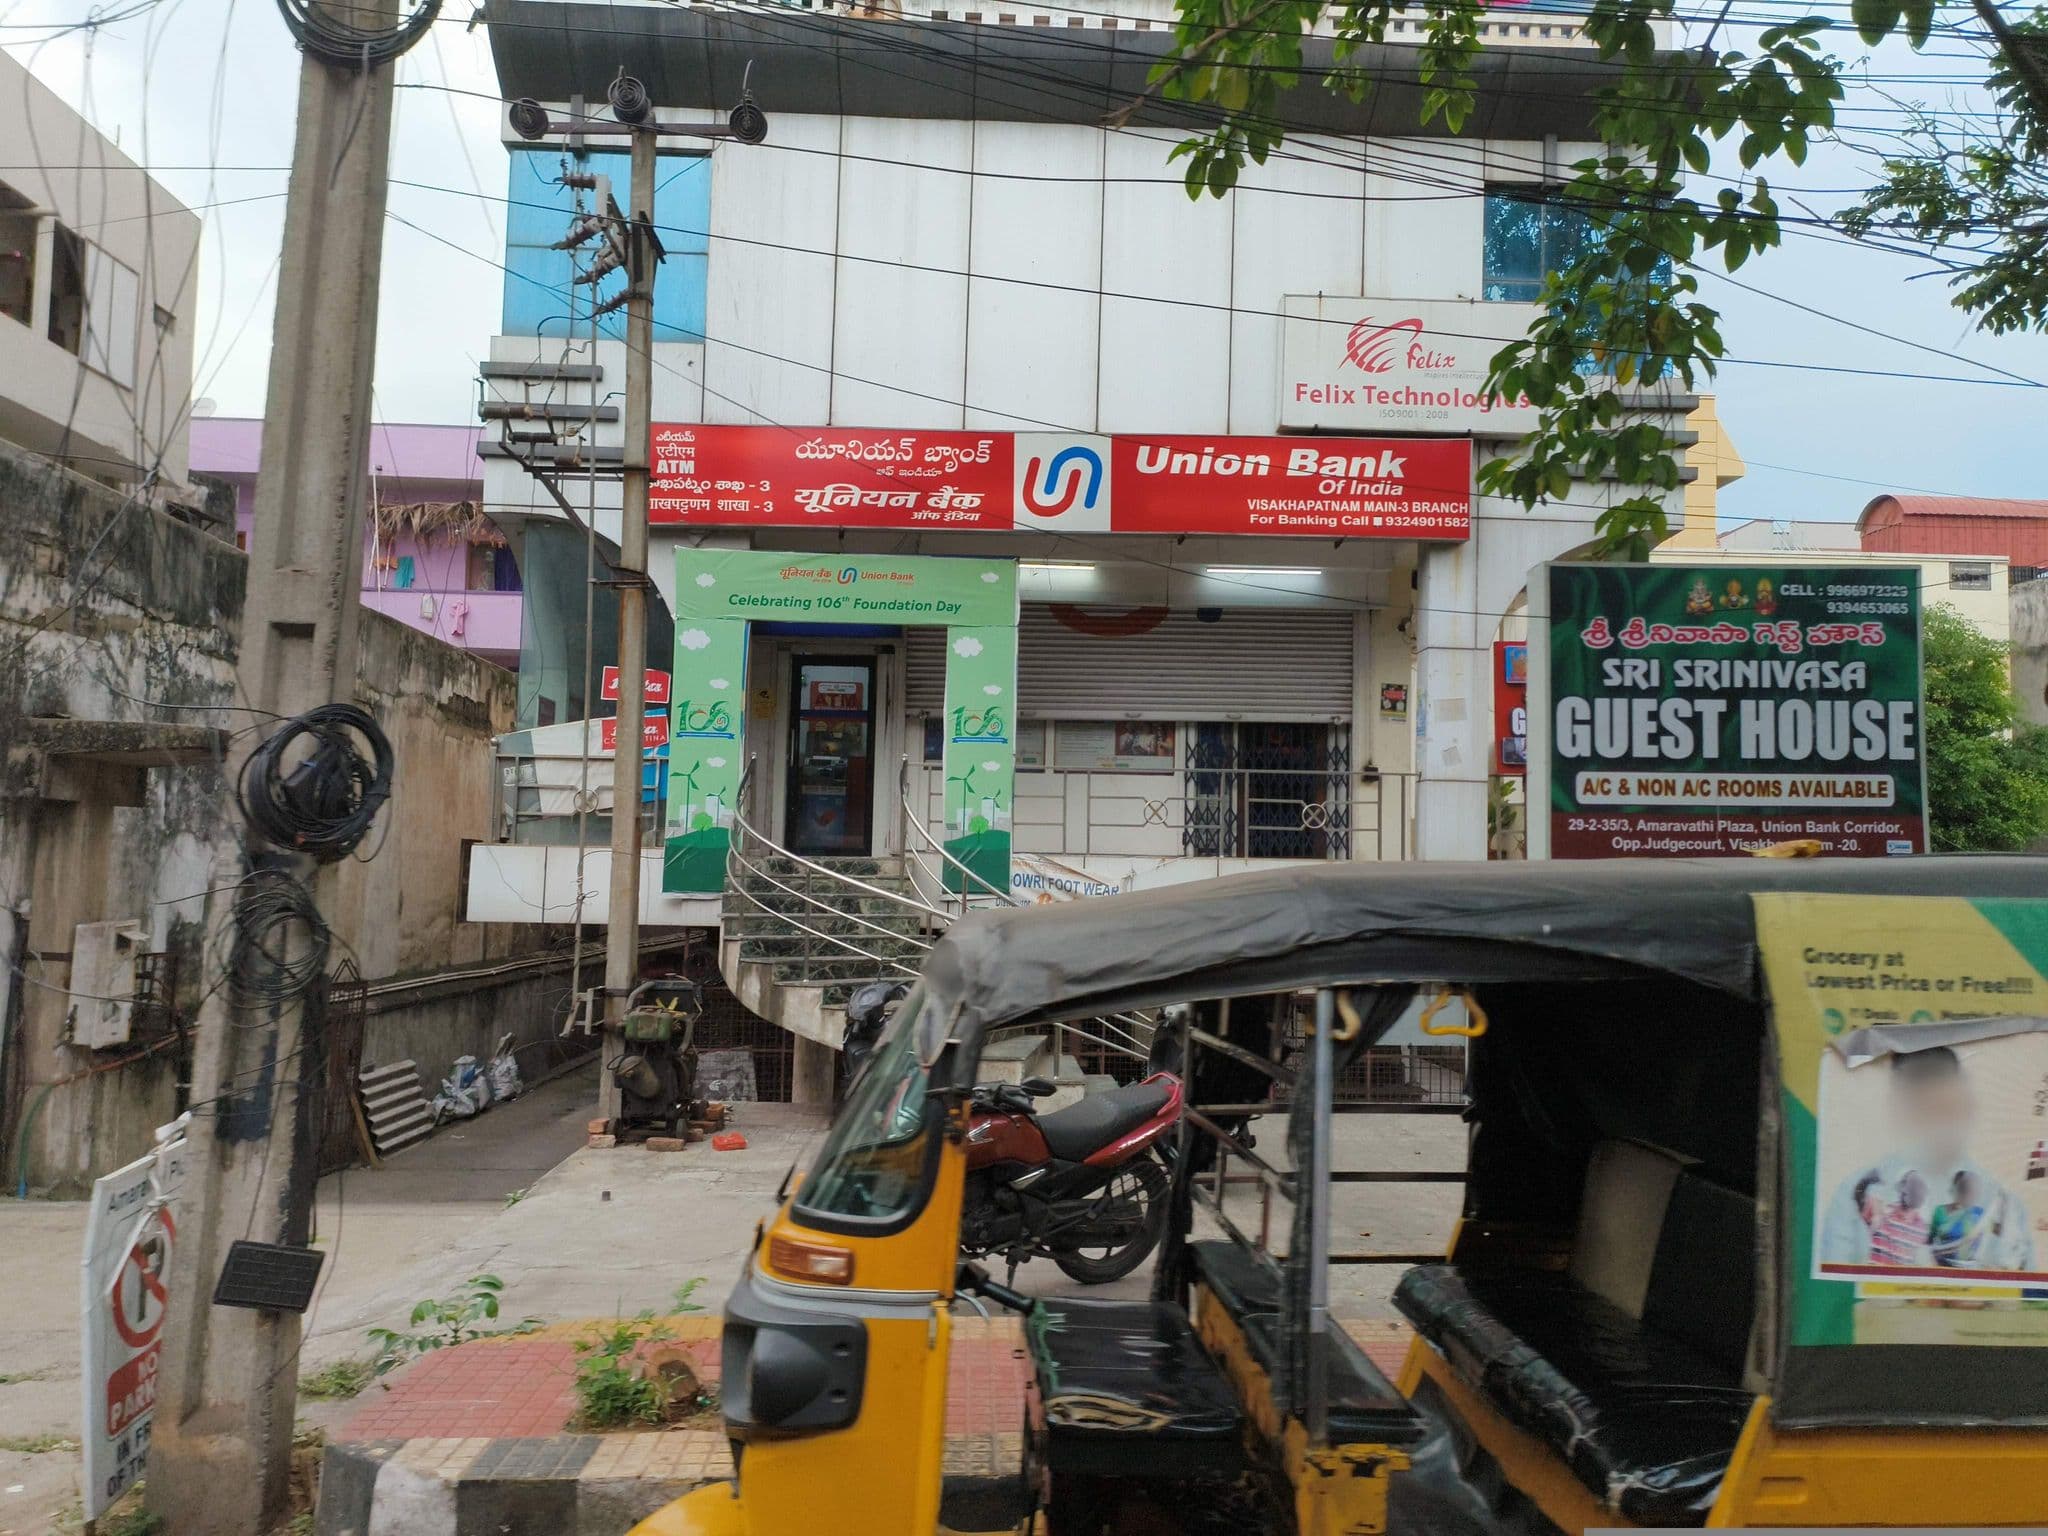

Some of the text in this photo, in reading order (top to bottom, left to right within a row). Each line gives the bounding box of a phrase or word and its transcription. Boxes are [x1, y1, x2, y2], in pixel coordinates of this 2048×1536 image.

[1296, 383, 1355, 404] Felix
[656, 443, 695, 458] एटीएम
[795, 437, 993, 473] యూనియన్ బ్యాంక్
[656, 460, 695, 474] ATM
[1136, 446, 1408, 478] Union Bank
[760, 480, 770, 491] 3
[1318, 479, 1403, 496] Of India
[717, 500, 750, 511] शाखा
[763, 501, 773, 512] 3
[794, 483, 985, 513] यूनियन बैंक
[1247, 499, 1468, 513] VISAKHAPATNAM MAIN-3 BRANCH
[1250, 515, 1468, 528] For Banking Call 9324901582
[861, 572, 914, 581] Union Bank
[1780, 584, 1815, 596] CELL
[728, 594, 812, 610] Celebrating
[853, 598, 932, 612] Foundation
[936, 601, 962, 614] Day
[1581, 616, 1614, 648] శ్రీ
[1602, 658, 1867, 692] SRI SRINIVASA
[1556, 696, 1727, 760] GUEST
[1740, 699, 1915, 762] HOUSE
[1583, 777, 1889, 799] A/C & NON A/C ROOMS AVAILABLE
[1568, 819, 1905, 835] 29-2-35/3, Amaravathi Plaza, Union Bank Corridor,
[1011, 873, 1120, 896] OWRI FOOT WEAR
[1803, 947, 1904, 969] Grocery at
[1805, 972, 1875, 990] Lowest
[1880, 974, 1930, 991] Price
[1935, 979, 1954, 992] or
